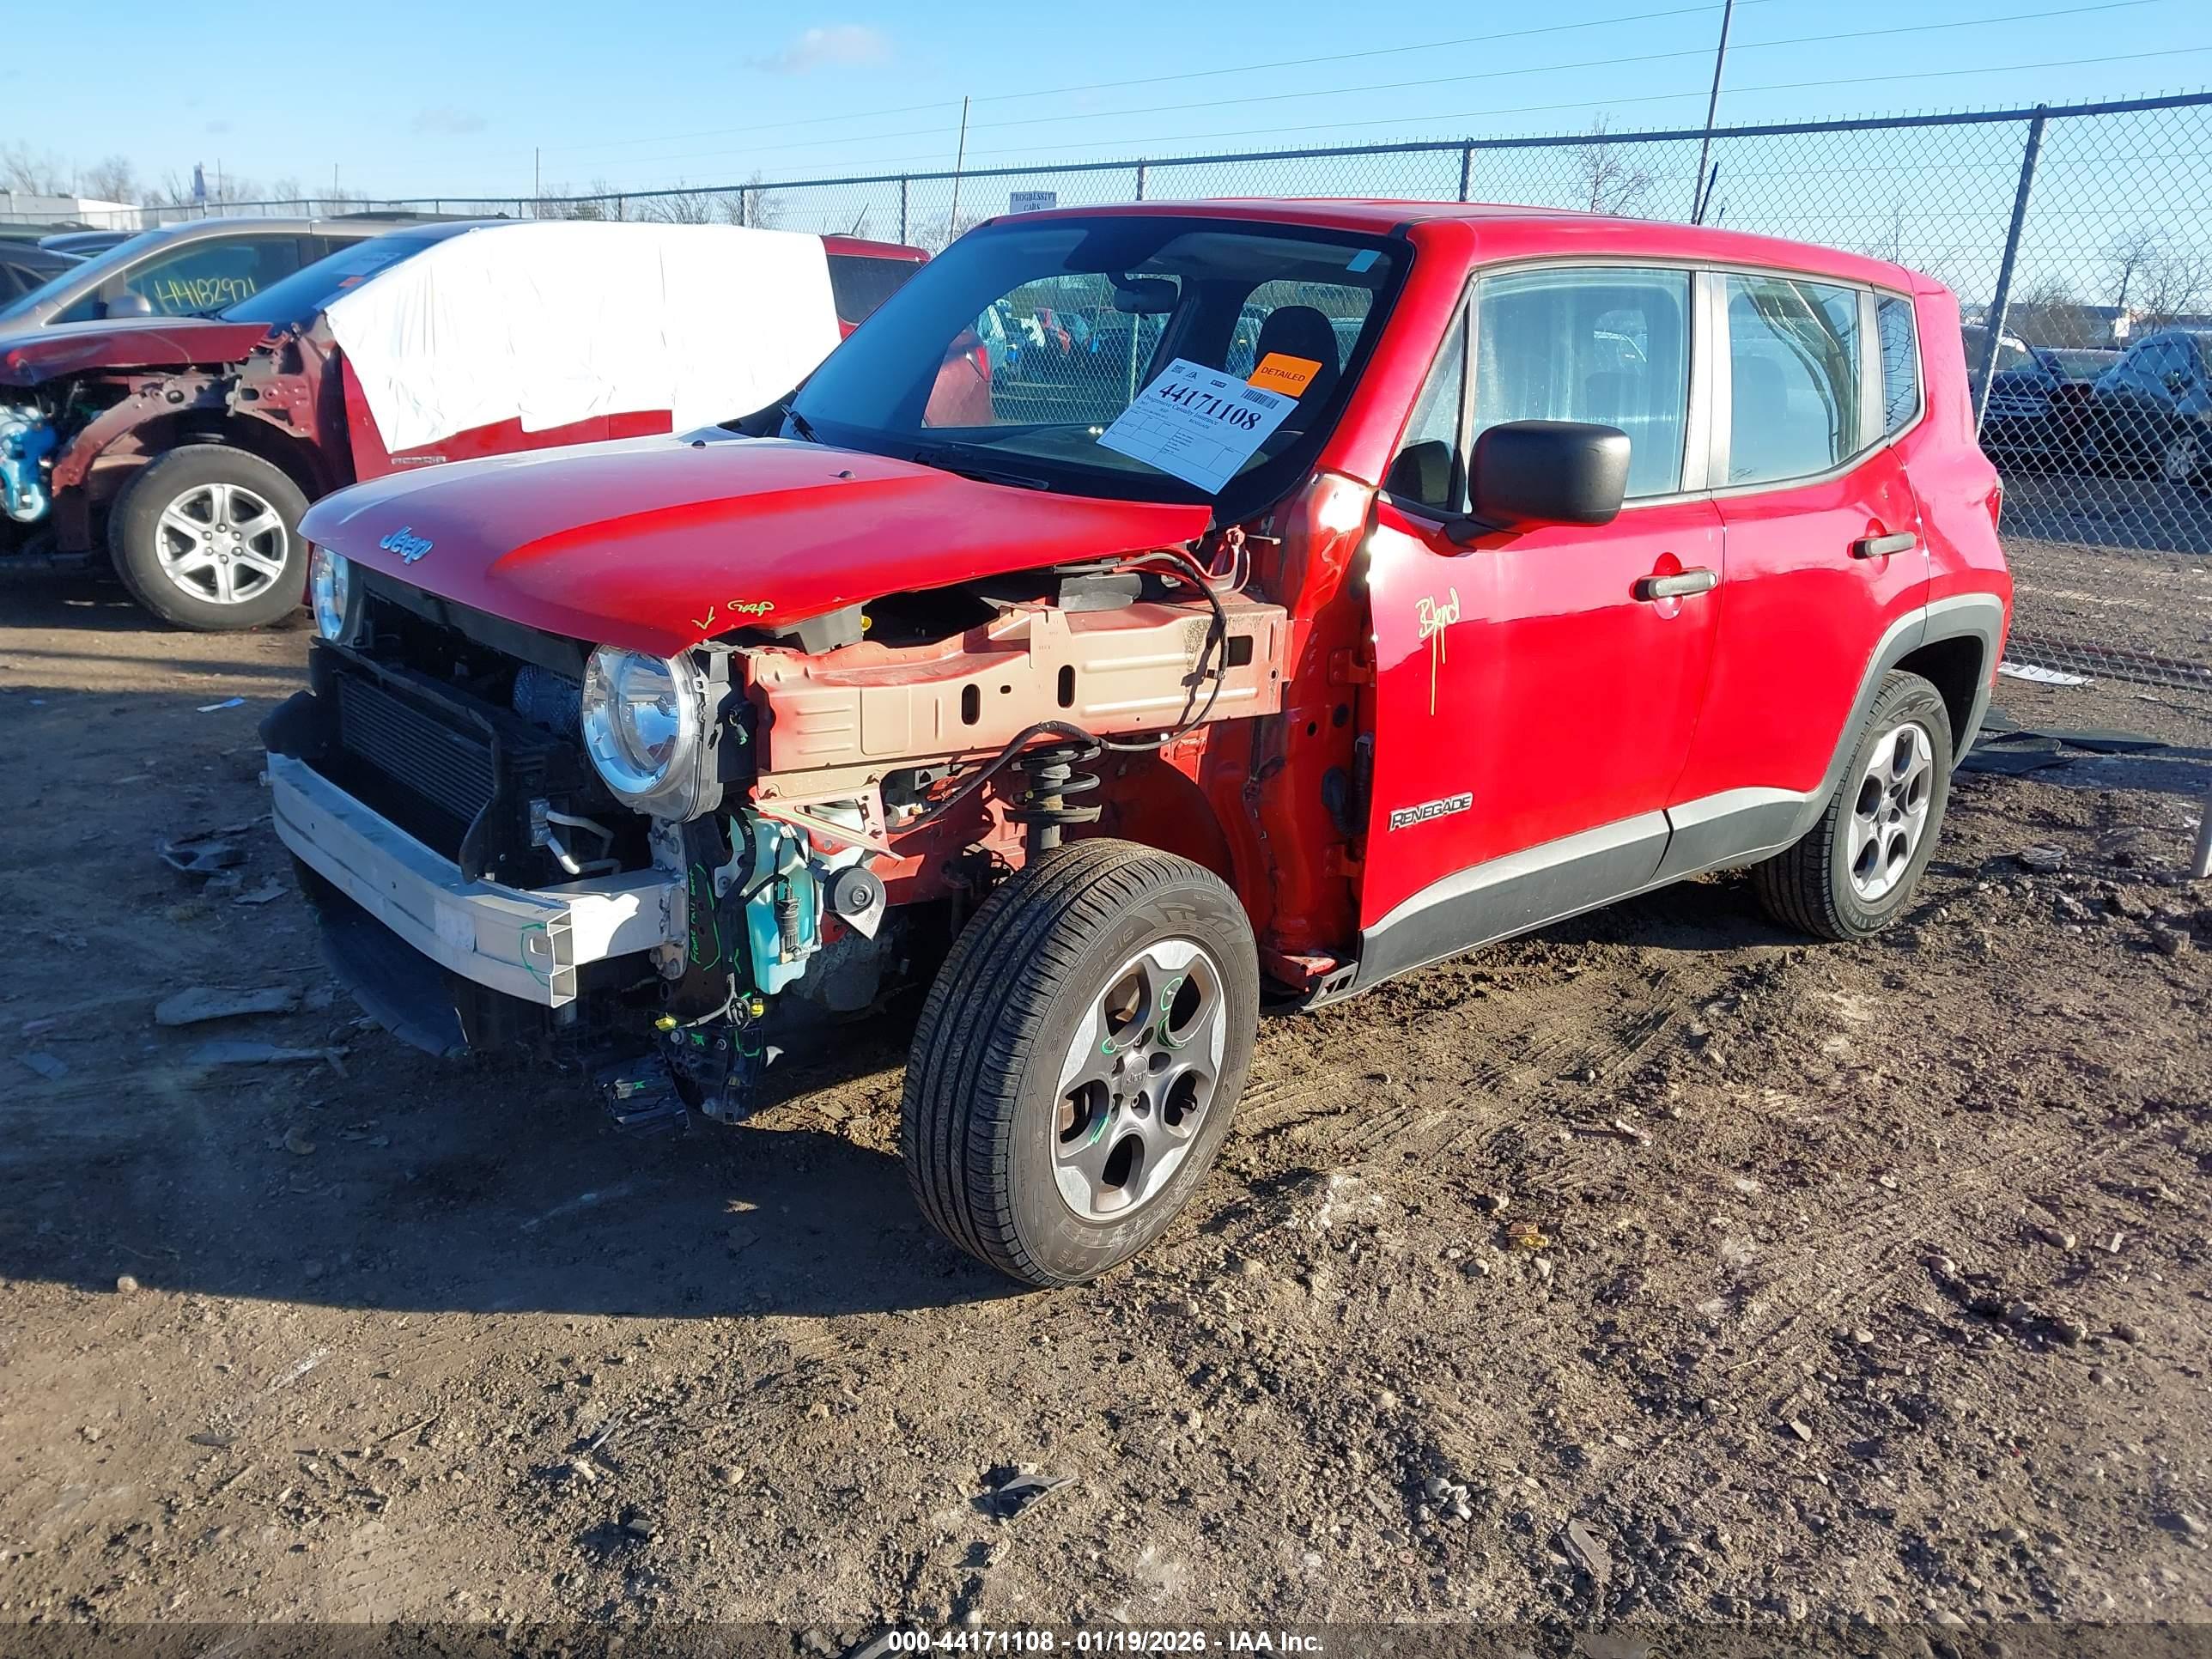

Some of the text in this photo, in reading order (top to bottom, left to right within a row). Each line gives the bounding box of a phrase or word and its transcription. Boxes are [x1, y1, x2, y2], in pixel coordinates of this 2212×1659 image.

[1011, 191, 1057, 203] PROGRESSIVE
[1024, 202, 1041, 212] CARS
[155, 276, 256, 308] 44182971
[1261, 366, 1306, 382] DETAILED
[1159, 382, 1262, 430] 44171108
[1194, 412, 1219, 426] Insurance
[380, 526, 434, 565] Jeep
[1415, 586, 1461, 639] Blend
[1389, 793, 1473, 830] RENEGADE
